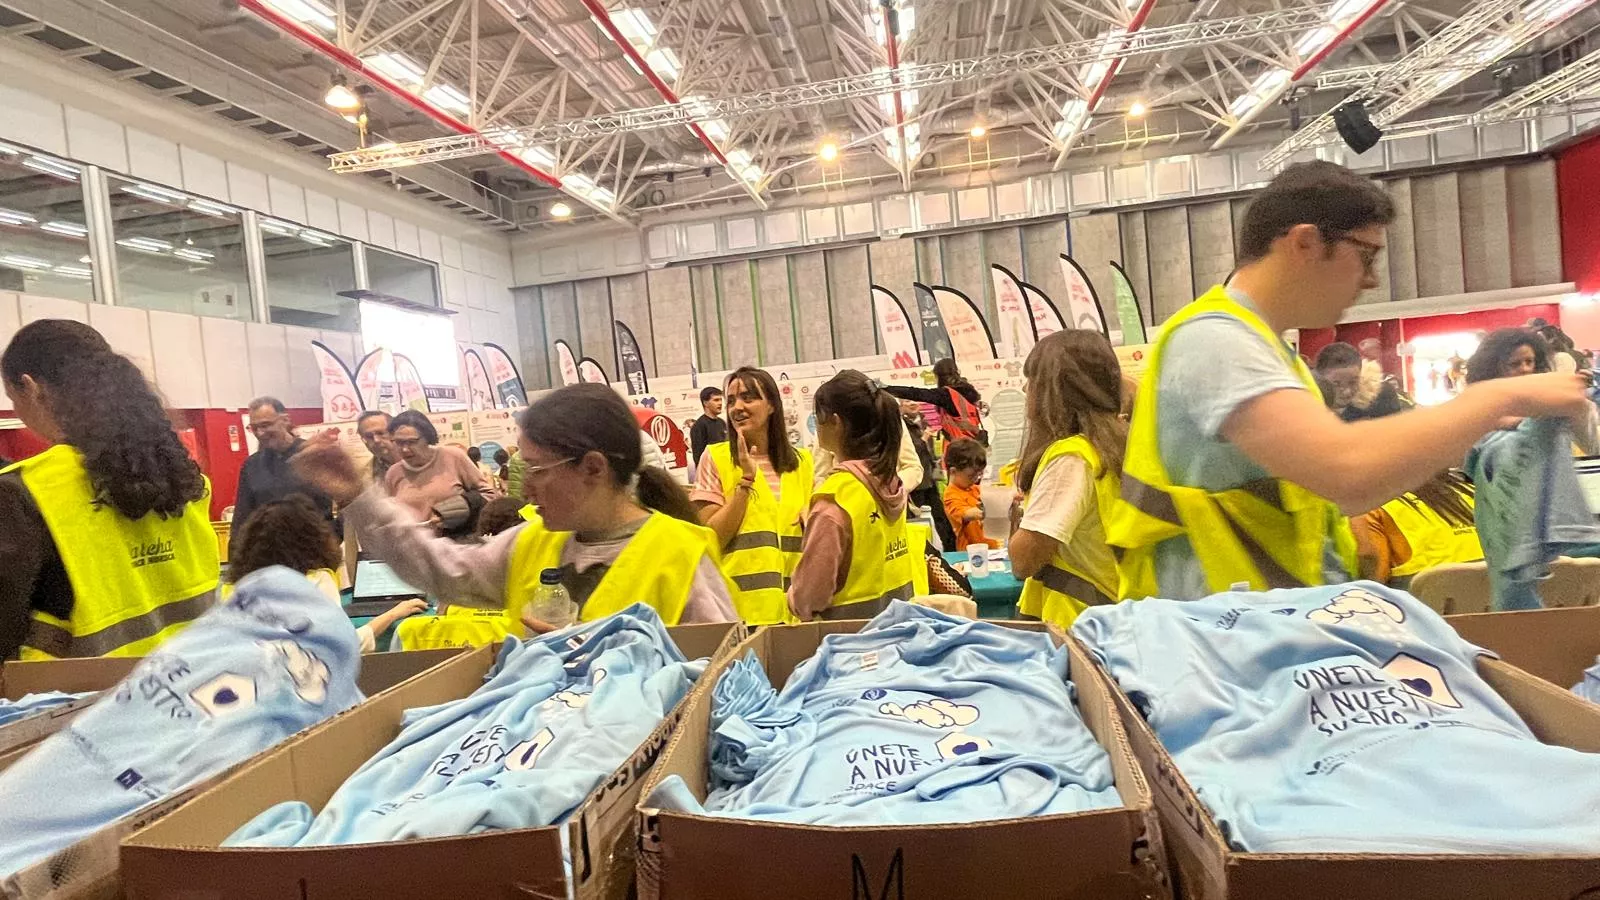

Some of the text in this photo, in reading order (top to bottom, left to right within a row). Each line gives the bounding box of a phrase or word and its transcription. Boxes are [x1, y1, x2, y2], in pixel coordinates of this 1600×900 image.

[681, 393, 688, 401] 7
[1309, 694, 1328, 725] A
[851, 765, 866, 785] A
[851, 846, 904, 900] M
